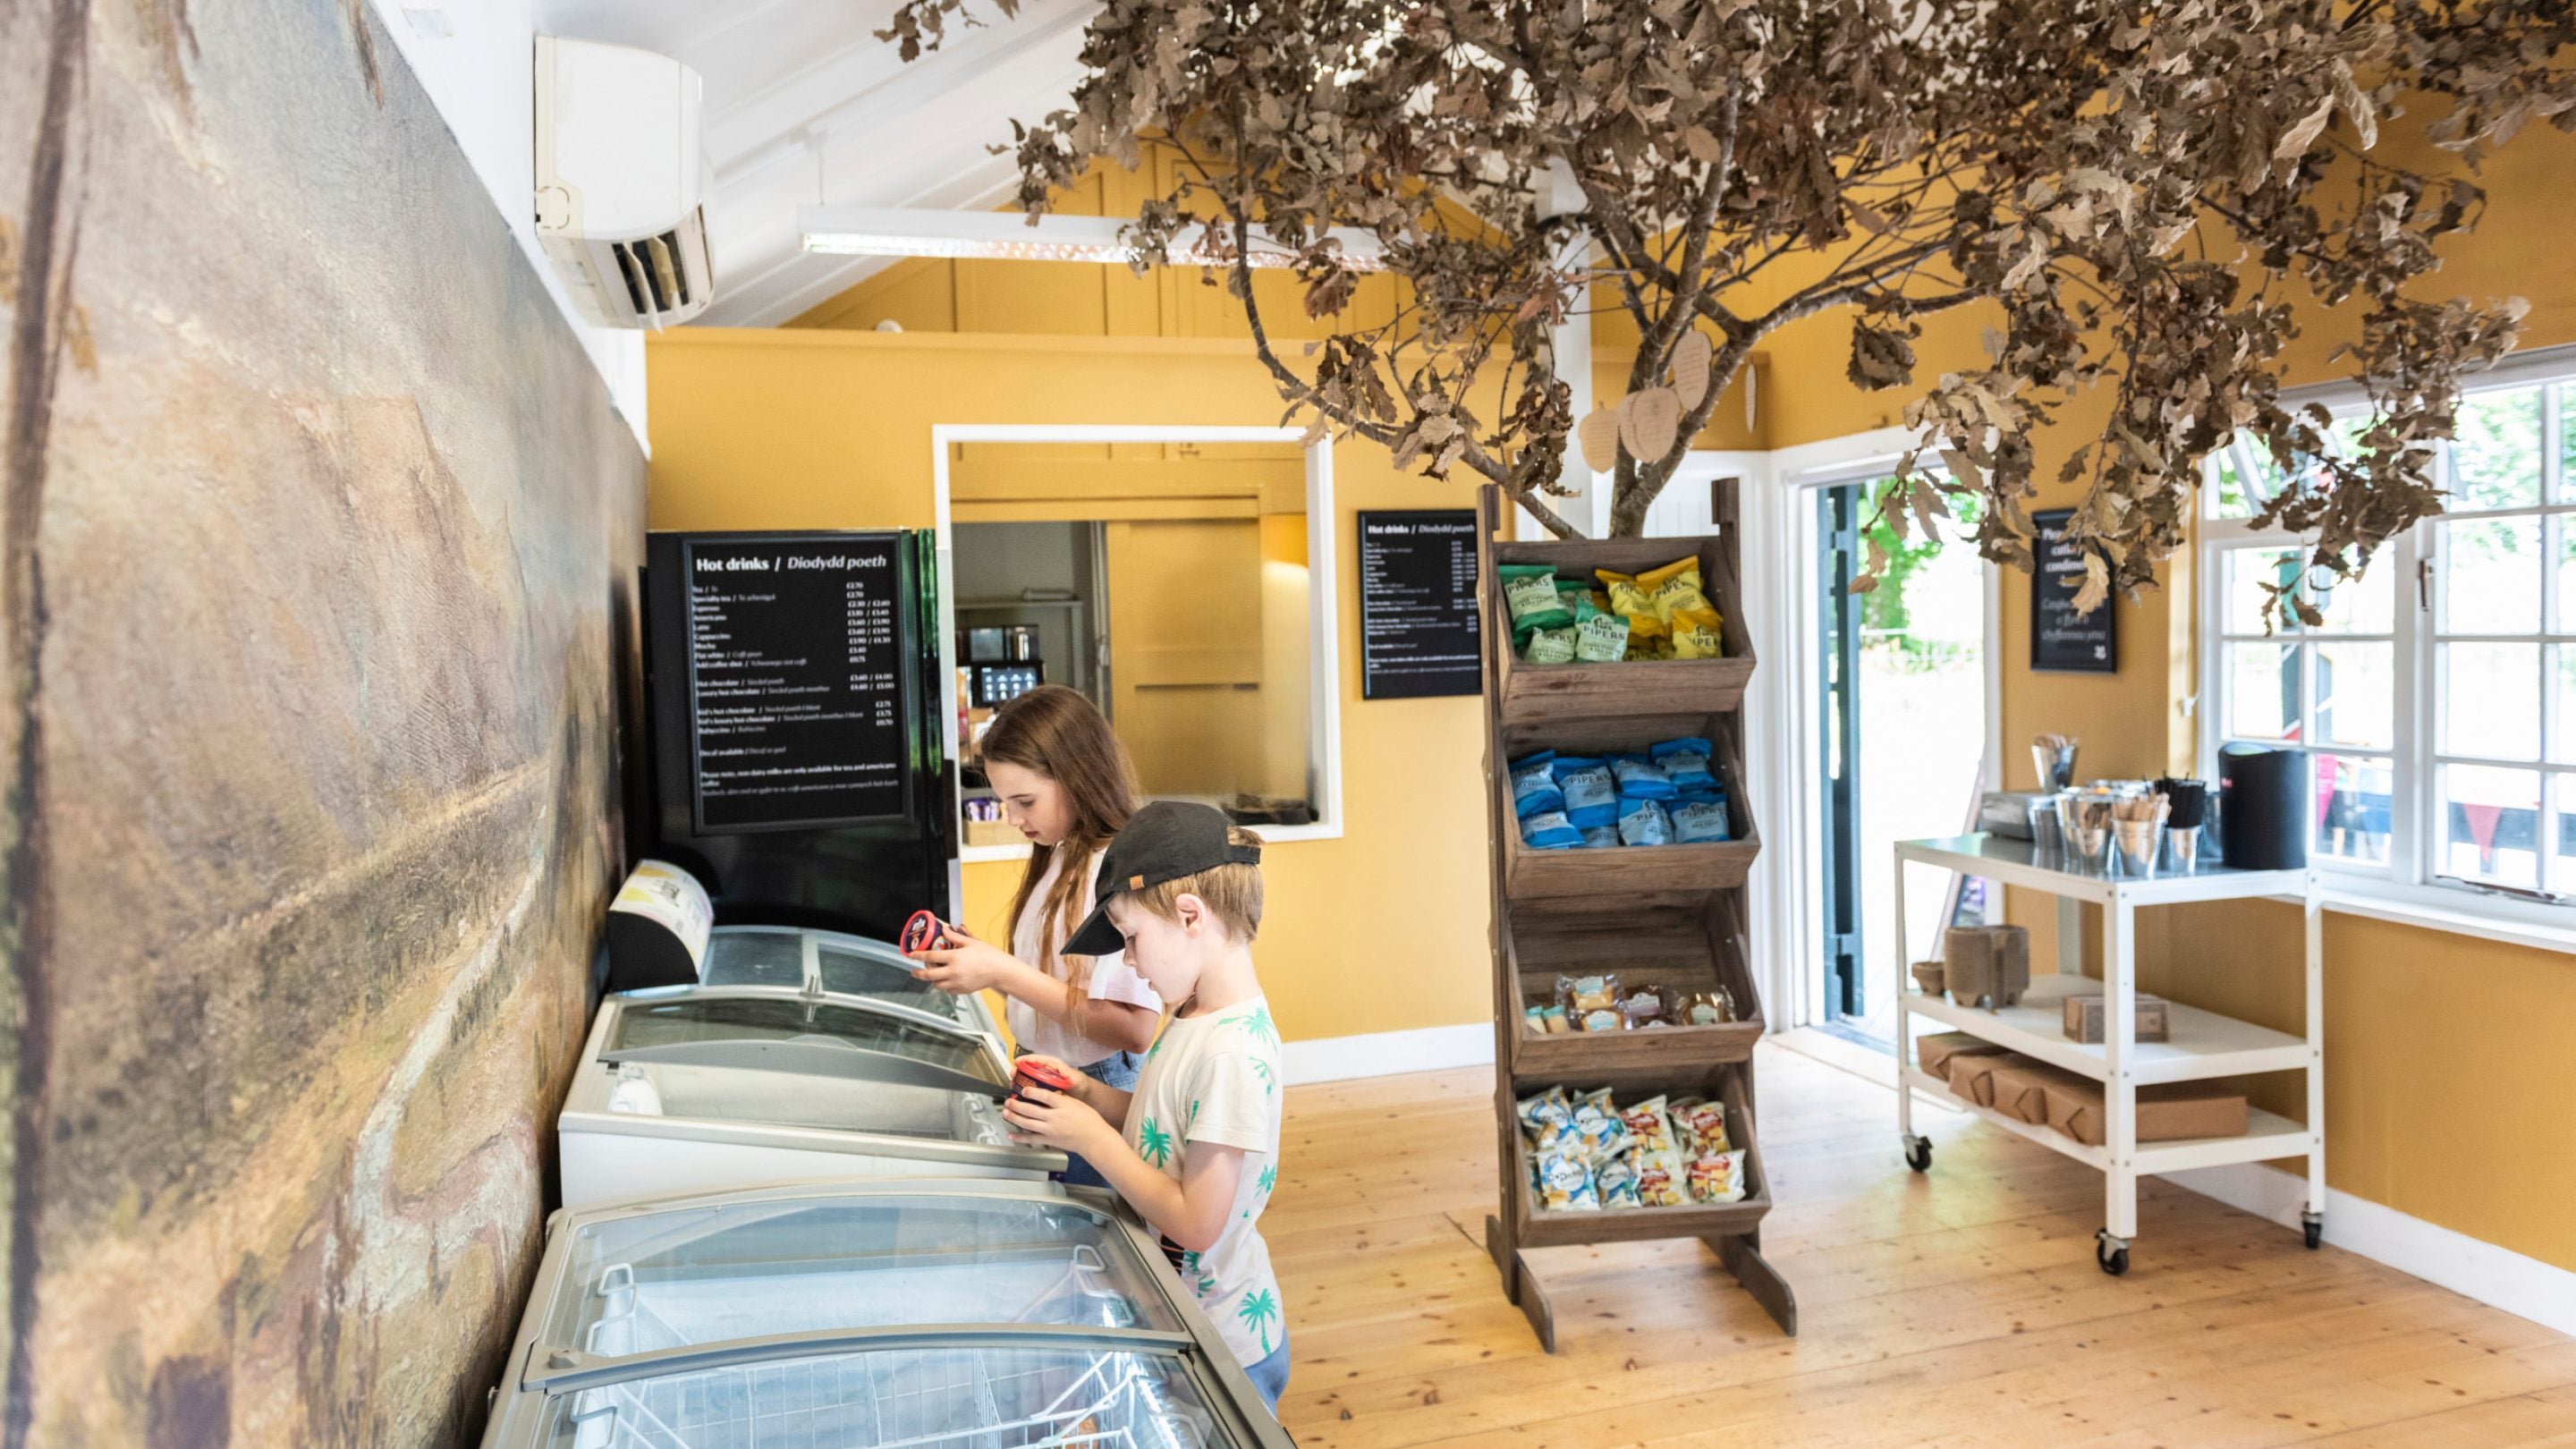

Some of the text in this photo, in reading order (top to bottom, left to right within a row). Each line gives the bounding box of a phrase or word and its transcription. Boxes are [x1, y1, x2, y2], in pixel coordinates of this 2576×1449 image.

[696, 555, 886, 572] Hot drinks / Diodydd poeth
[1583, 625, 1625, 640] PIPERS
